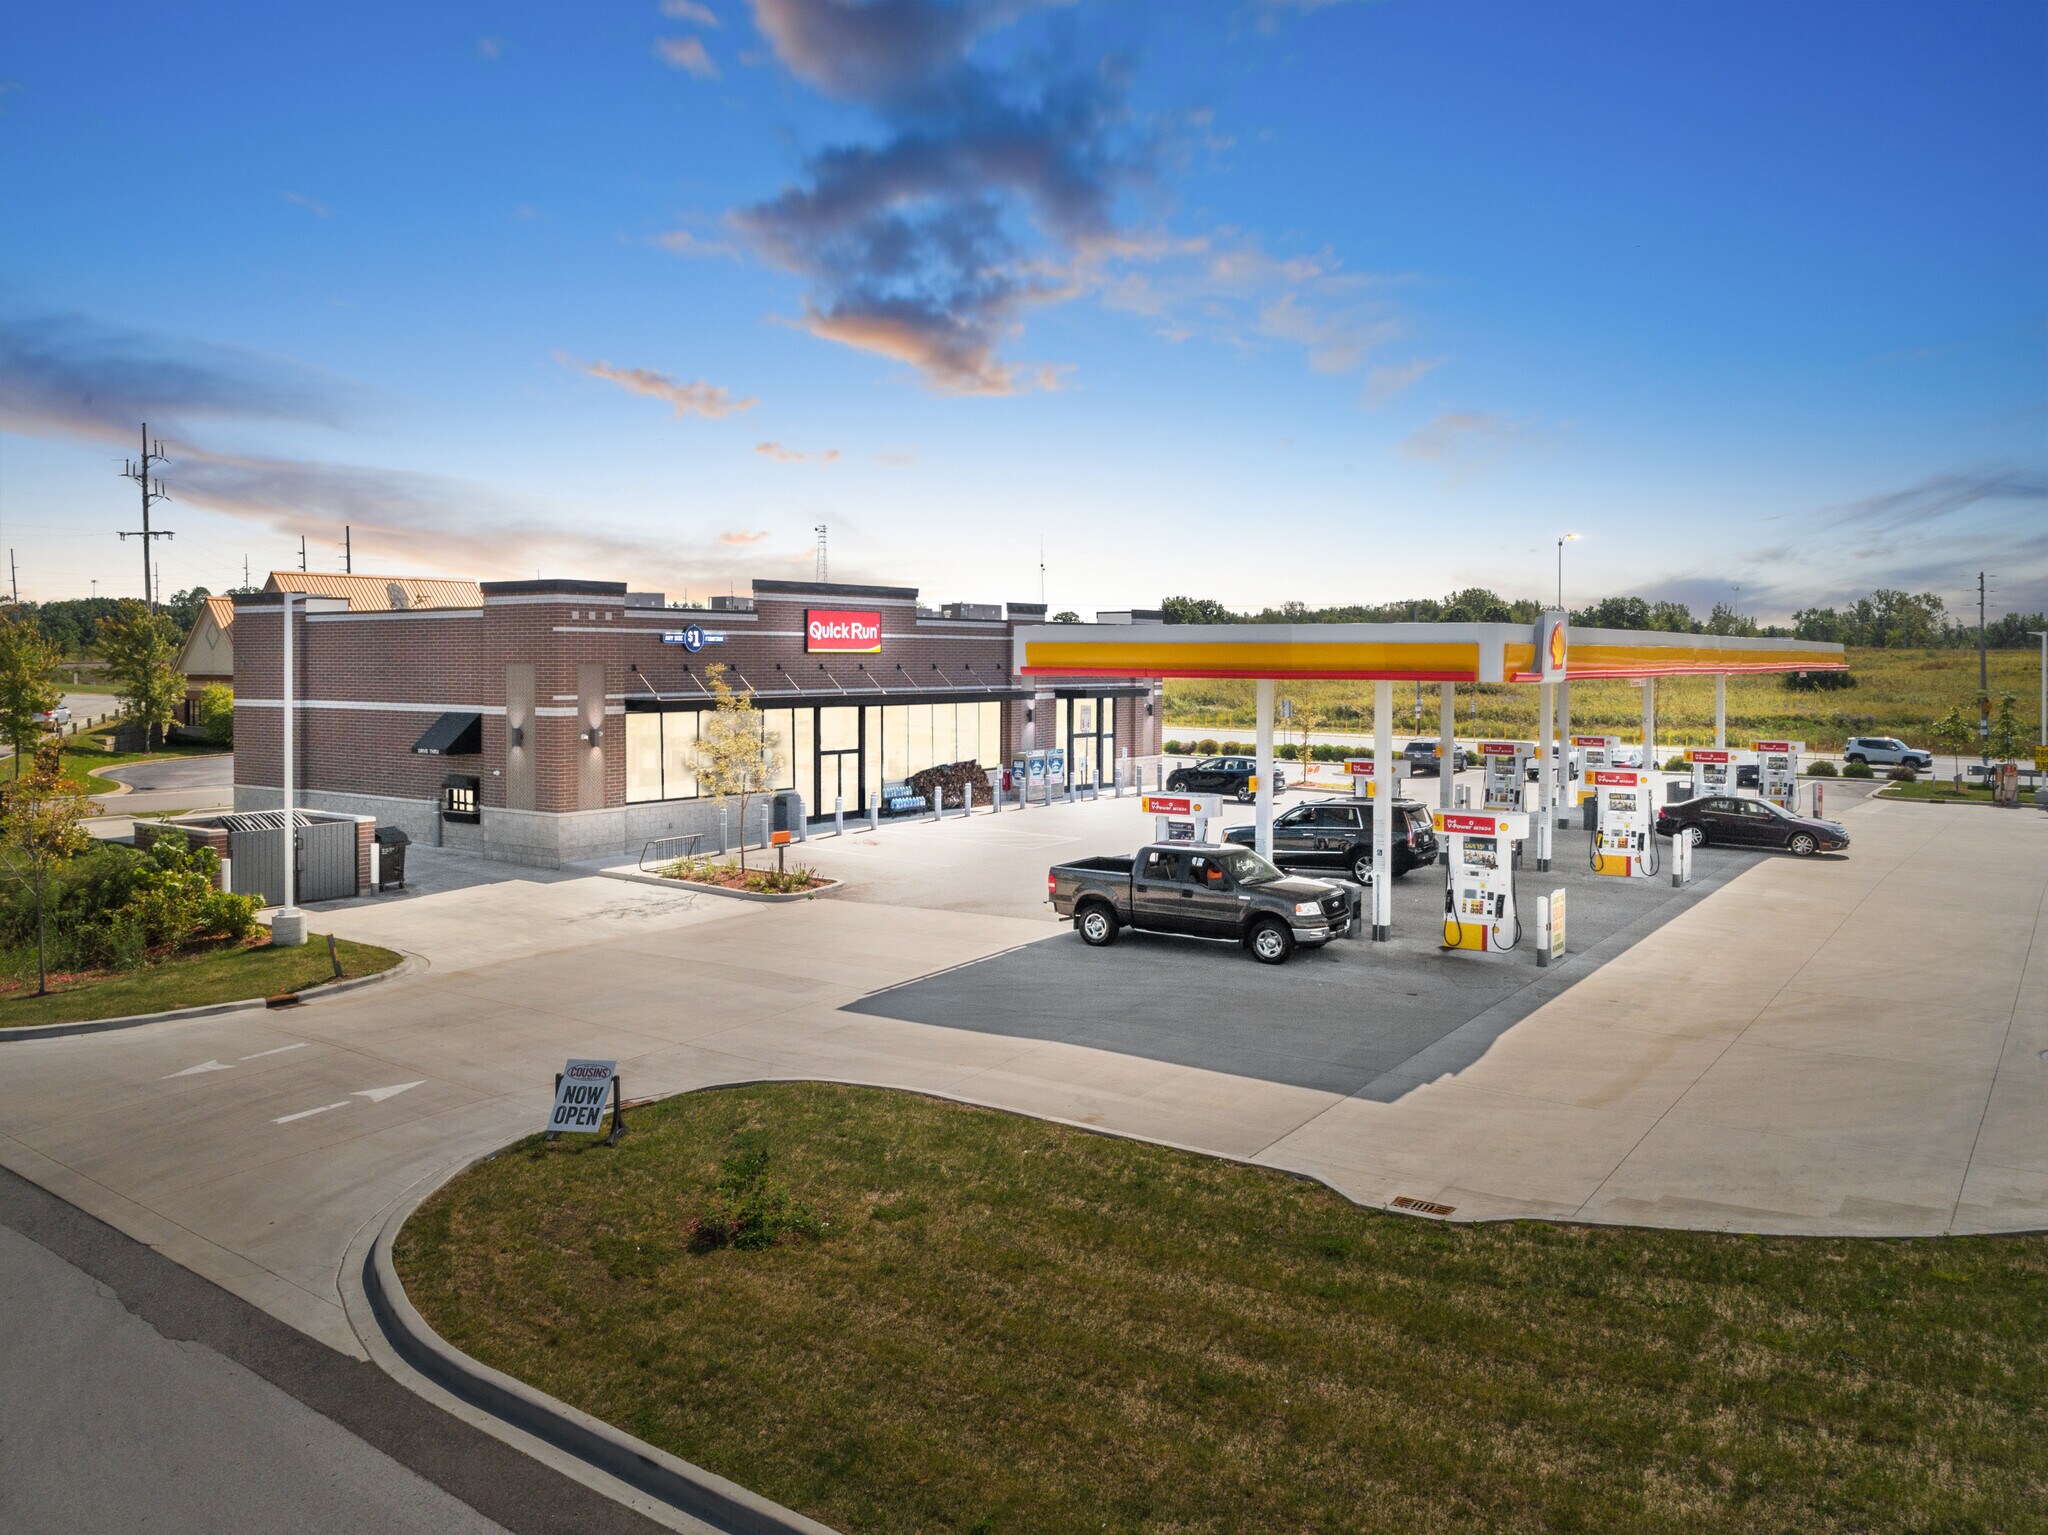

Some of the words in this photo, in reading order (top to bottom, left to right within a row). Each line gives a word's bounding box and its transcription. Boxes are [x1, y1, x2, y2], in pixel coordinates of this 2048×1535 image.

[687, 630, 701, 647] $1
[809, 621, 850, 640] Quick
[851, 622, 878, 640] Run
[570, 1067, 608, 1078] COUSINS
[562, 1086, 604, 1104] NOW
[554, 1106, 600, 1126] OPEN
